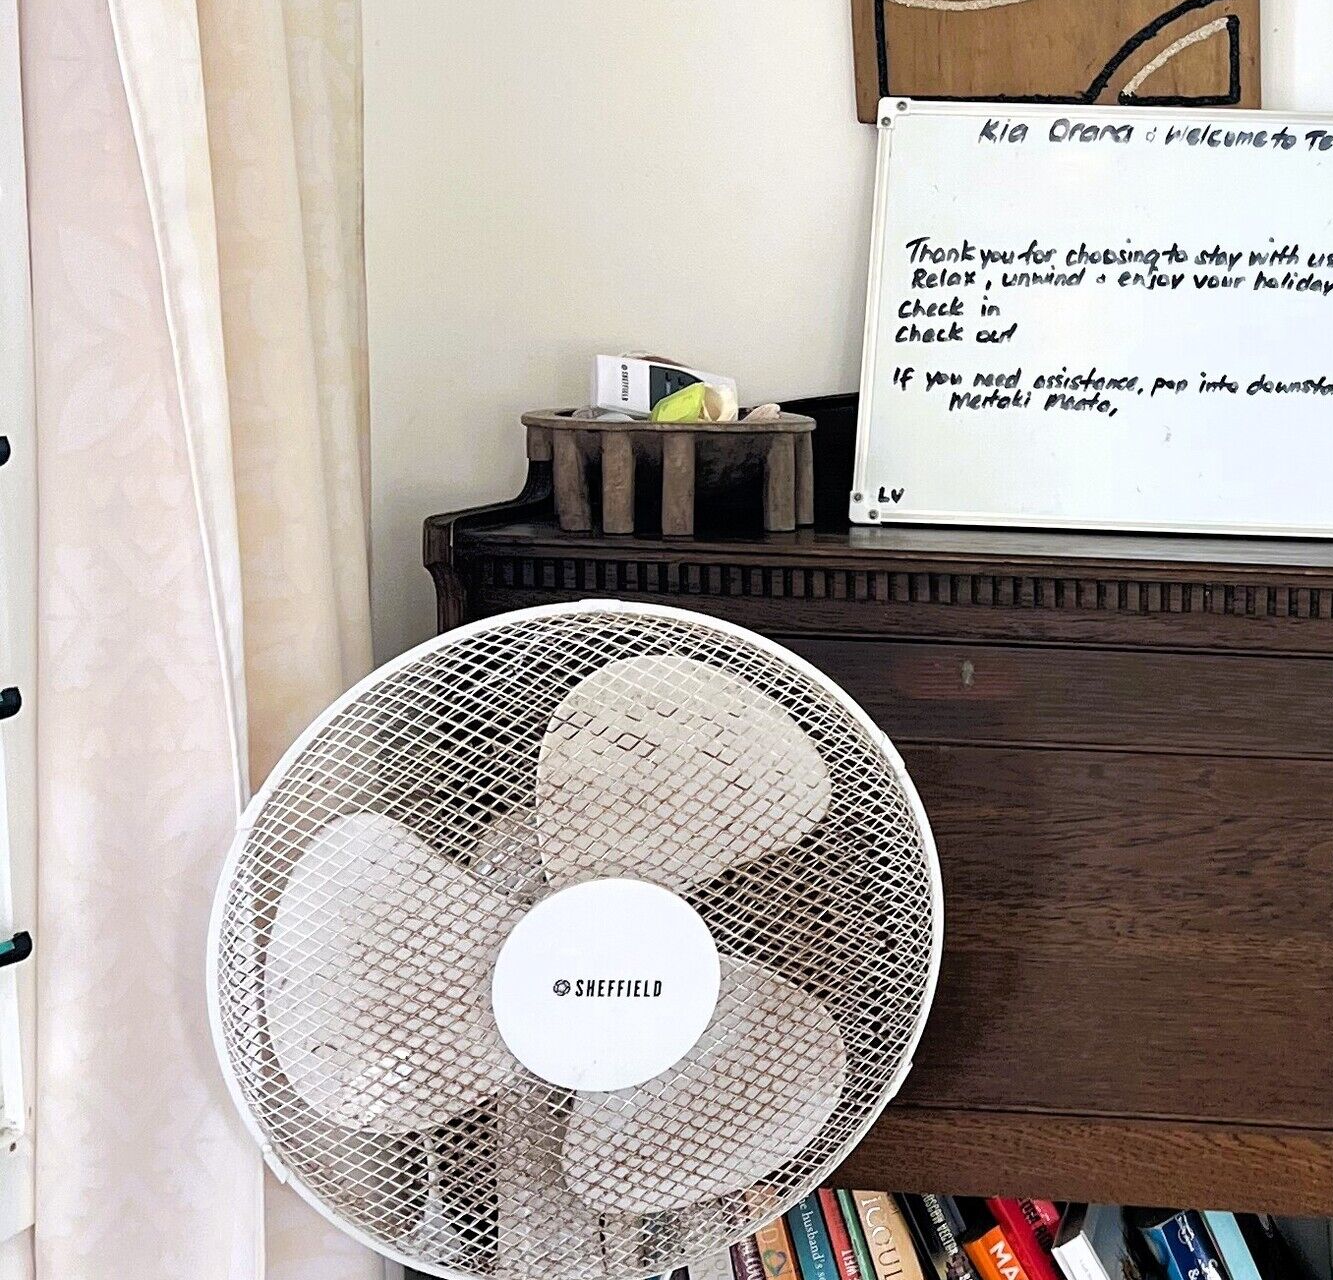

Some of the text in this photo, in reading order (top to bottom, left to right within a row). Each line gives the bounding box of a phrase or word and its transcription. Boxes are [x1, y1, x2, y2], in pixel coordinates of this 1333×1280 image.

[978, 118, 1029, 145] Kia
[1164, 124, 1270, 149] Welcome
[1271, 126, 1298, 150] to
[1305, 130, 1333, 150] Te
[905, 236, 977, 264] Thank
[979, 247, 1015, 270] you
[1017, 239, 1058, 265] for
[1065, 237, 1162, 273] choosing
[1162, 242, 1189, 264] to
[1193, 244, 1243, 272] stay
[1249, 236, 1300, 267] with
[1001, 265, 1086, 287] unwind
[980, 295, 1001, 317] in
[975, 322, 1018, 343] out
[893, 366, 915, 391] If
[925, 370, 962, 392] you
[972, 367, 1022, 389] need
[1198, 371, 1240, 394] into
[575, 979, 662, 997] SHEFFIELD
[921, 1193, 945, 1225] OSCOW
[801, 1210, 826, 1270] husband's
